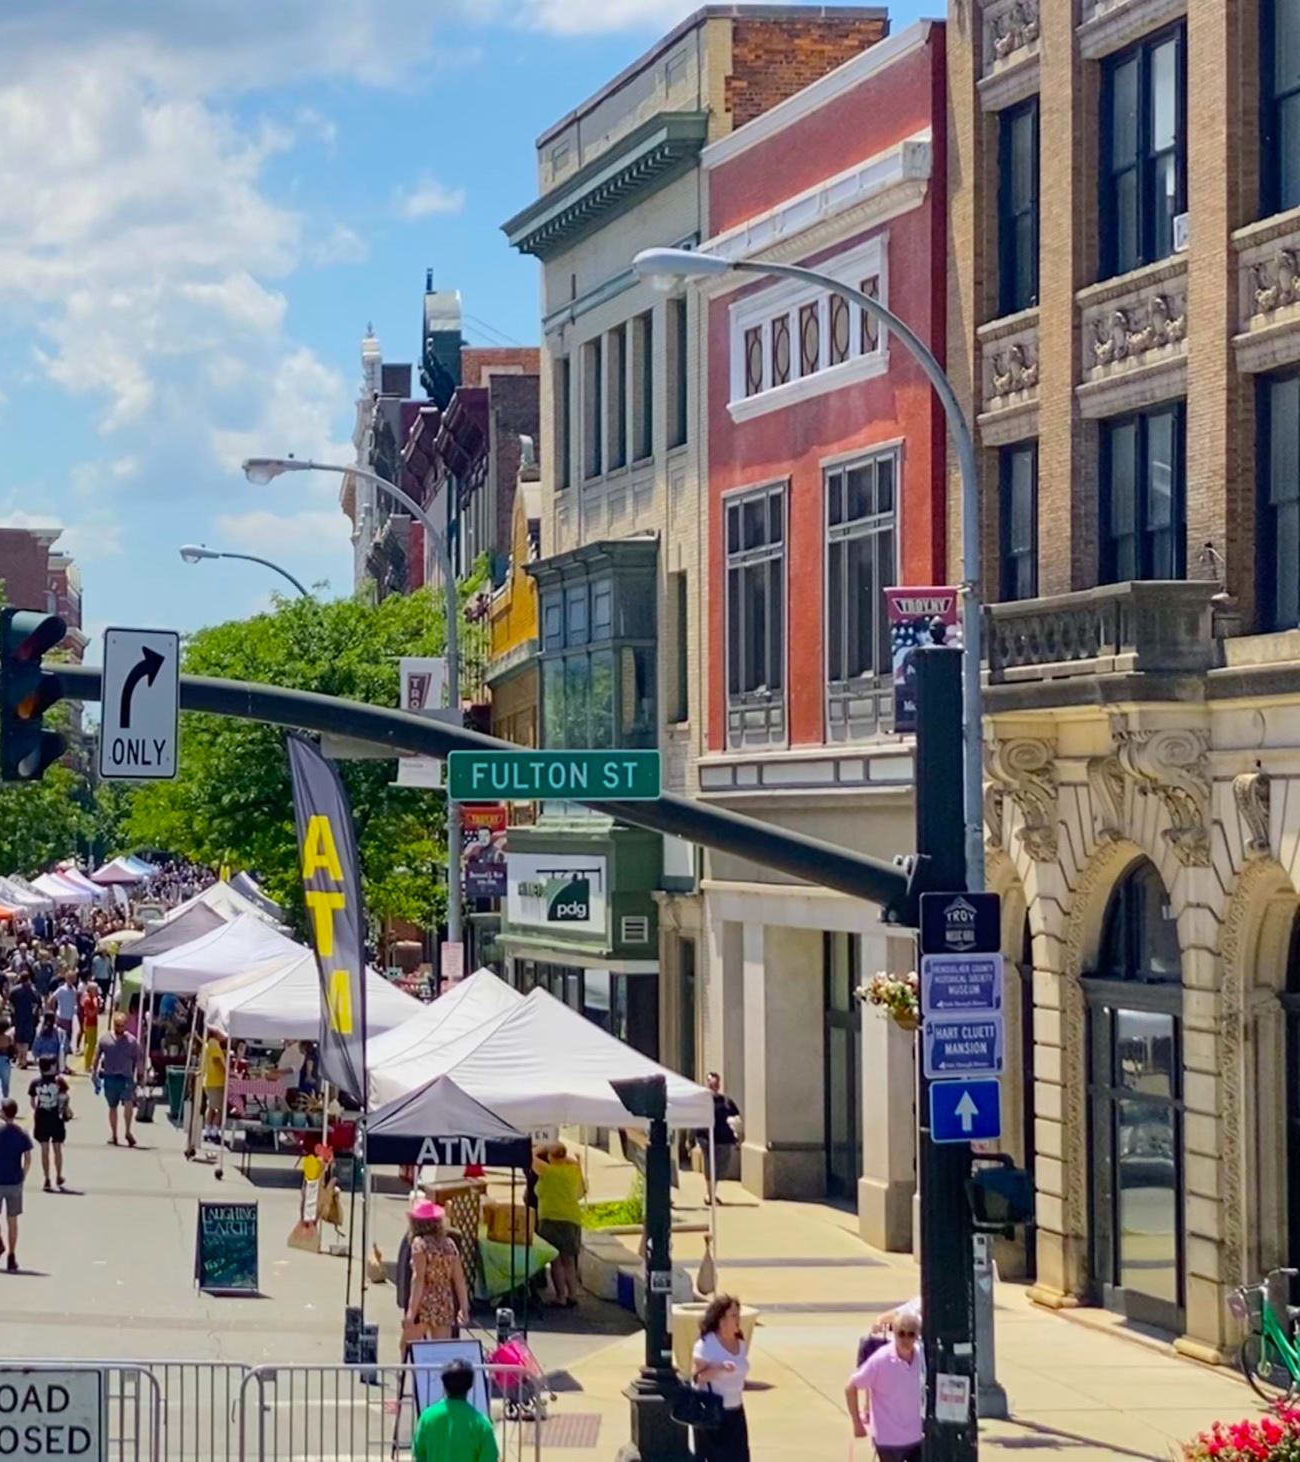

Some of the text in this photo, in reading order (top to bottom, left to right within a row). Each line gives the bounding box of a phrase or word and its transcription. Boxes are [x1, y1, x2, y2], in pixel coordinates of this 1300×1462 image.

[112, 738, 166, 766] ONLY
[471, 762, 638, 789] FULTON ST
[557, 901, 587, 917] pdg
[946, 910, 976, 922] TROY
[947, 984, 980, 995] MUSEUM
[935, 1025, 995, 1040] HART CLUETT
[944, 1042, 988, 1055] MANSION
[416, 1138, 487, 1165] ATM
[202, 1206, 256, 1224] LAUGHING
[204, 1221, 256, 1236] EARTH
